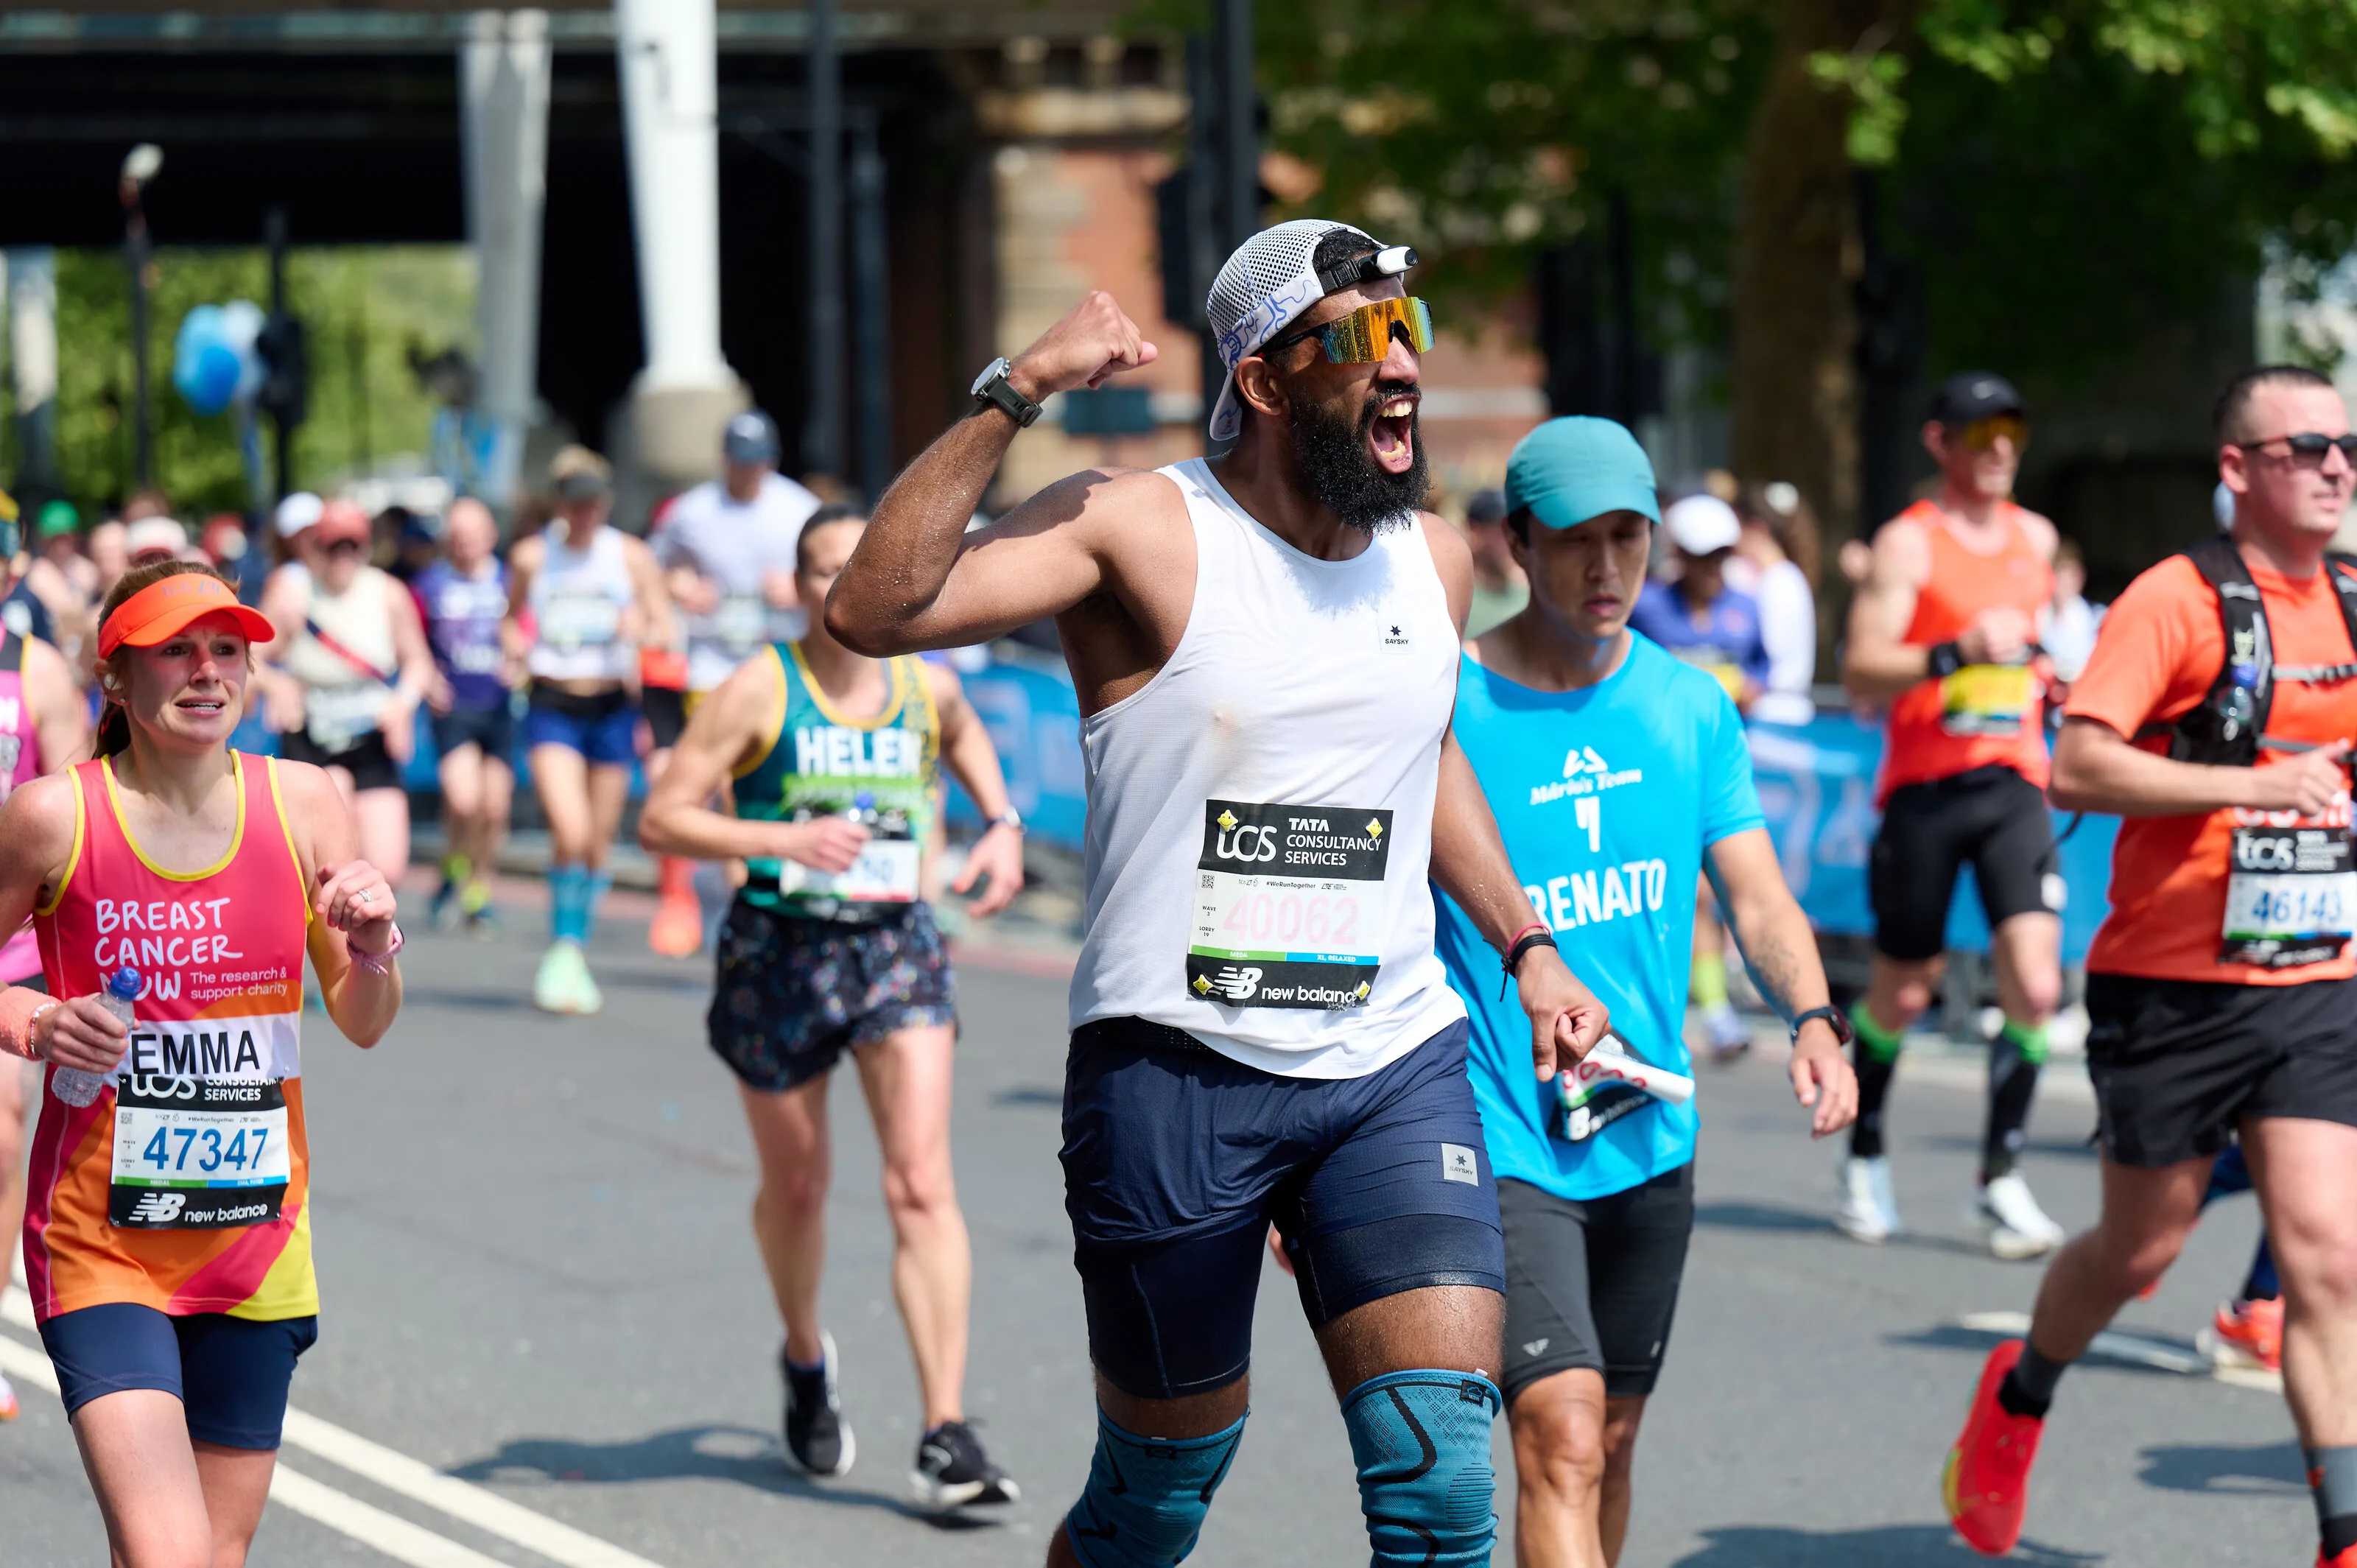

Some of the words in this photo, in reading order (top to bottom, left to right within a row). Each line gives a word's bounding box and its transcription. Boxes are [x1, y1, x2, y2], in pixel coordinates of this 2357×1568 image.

[1289, 818, 1330, 832] TATA
[1286, 834, 1382, 851] CONSULTANCY
[1285, 851, 1347, 866] SERVICES
[1266, 881, 1316, 889] #WeRunTogether
[1522, 857, 1668, 936] RENATO
[96, 897, 231, 935] BREAST
[1223, 892, 1360, 945] 40062
[94, 934, 244, 967] CANCER
[1328, 954, 1356, 963] RELAXED
[190, 971, 216, 984] The
[221, 967, 278, 983] research
[280, 966, 287, 979] &
[190, 985, 243, 1002] support
[247, 981, 287, 997] charity
[1261, 987, 1295, 999] new
[131, 1030, 260, 1075] EMMA
[204, 1088, 261, 1101] SERVICES
[143, 1126, 269, 1172] 47347
[1449, 1166, 1473, 1175] SAYSKY
[184, 1208, 215, 1223] new
[217, 1203, 268, 1222] balance
